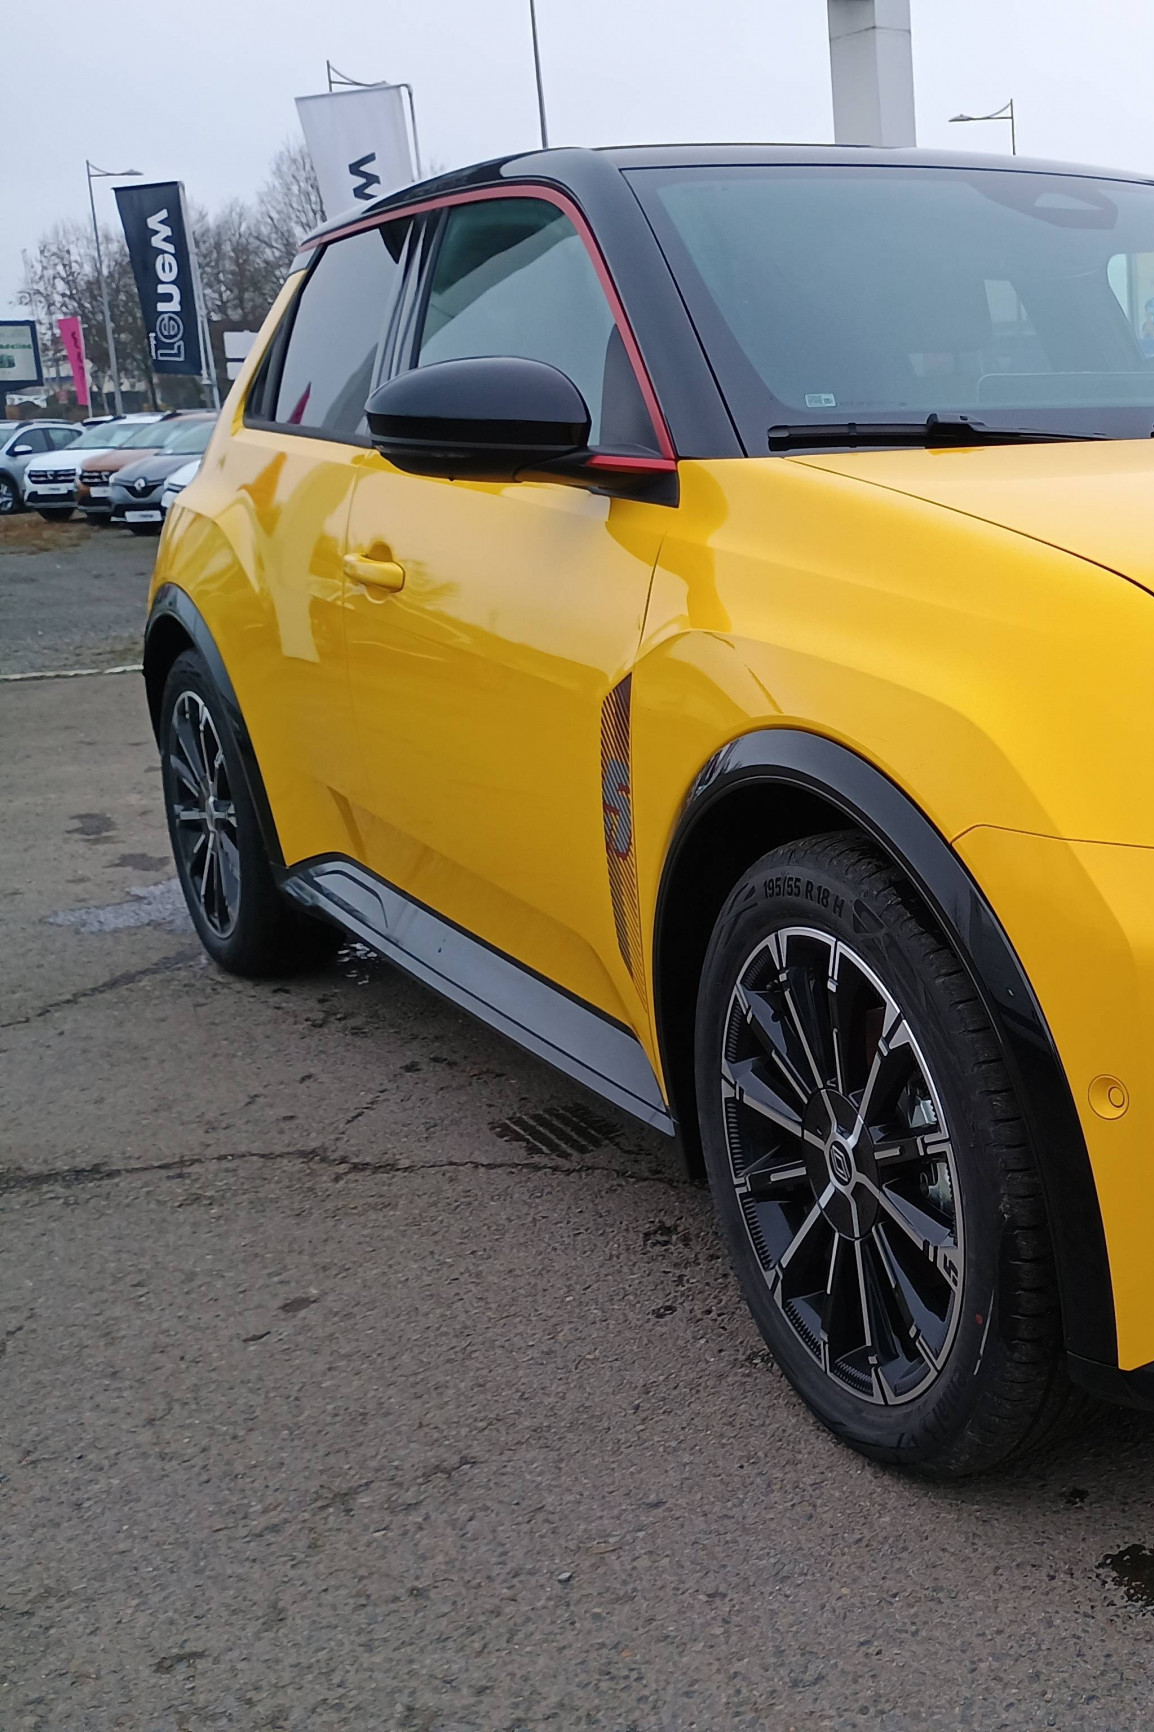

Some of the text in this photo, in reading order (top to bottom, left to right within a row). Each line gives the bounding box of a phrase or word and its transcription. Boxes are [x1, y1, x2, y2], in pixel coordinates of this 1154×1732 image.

[146, 208, 185, 362] renew
[763, 876, 801, 899] 195/55
[816, 885, 831, 908] 18
[832, 895, 845, 918] H
